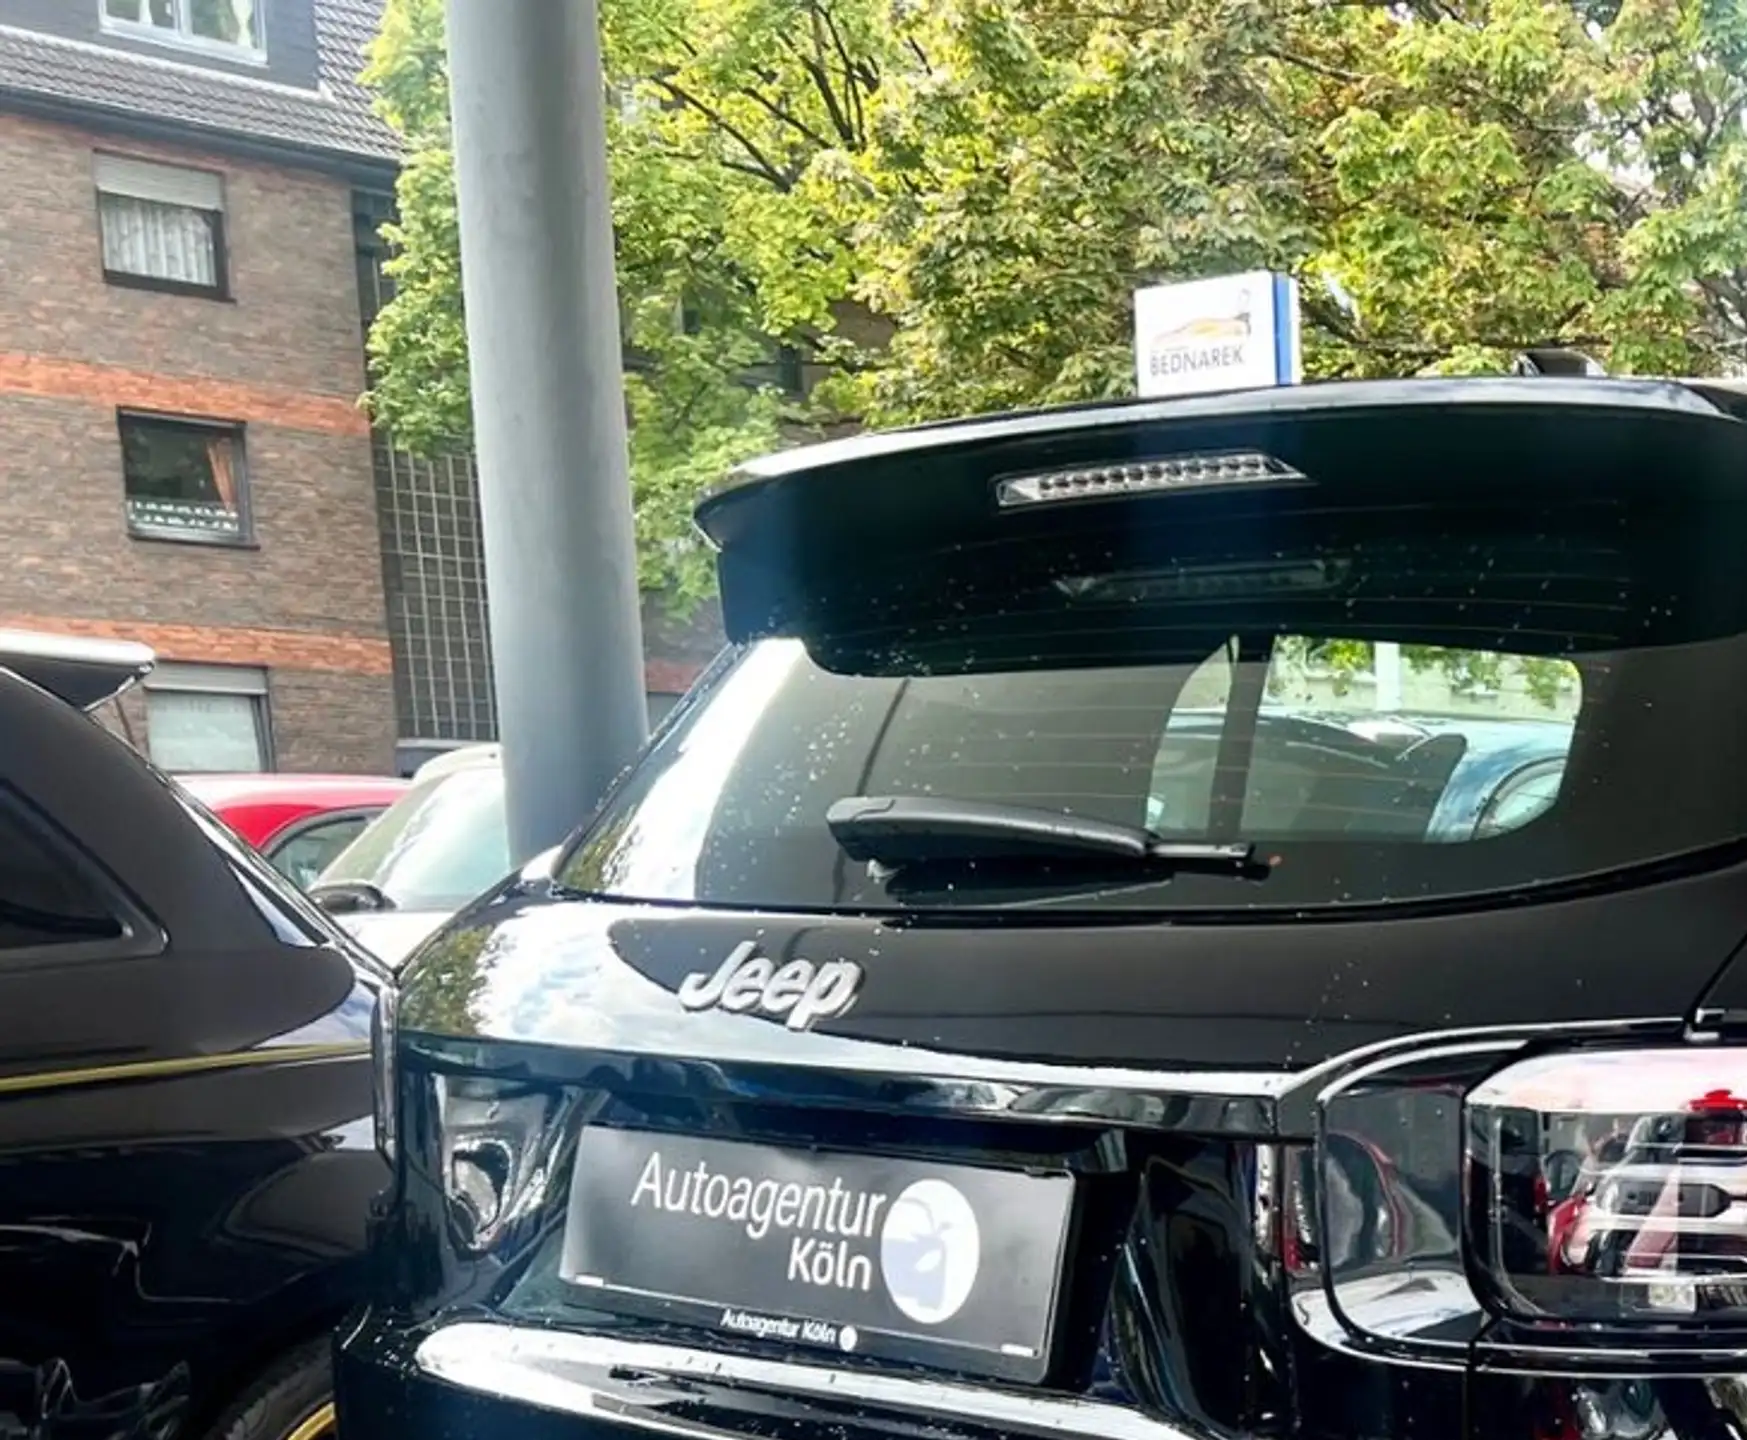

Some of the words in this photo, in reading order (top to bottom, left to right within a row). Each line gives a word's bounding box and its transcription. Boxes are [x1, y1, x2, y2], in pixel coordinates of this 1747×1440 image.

[1150, 345, 1245, 376] BEDNAREK
[678, 941, 866, 1032] Jeep
[630, 1150, 887, 1240] Autoagentur
[787, 1235, 872, 1292] Köln
[719, 1307, 801, 1339] Autoagentur
[801, 1319, 837, 1345] Köln
